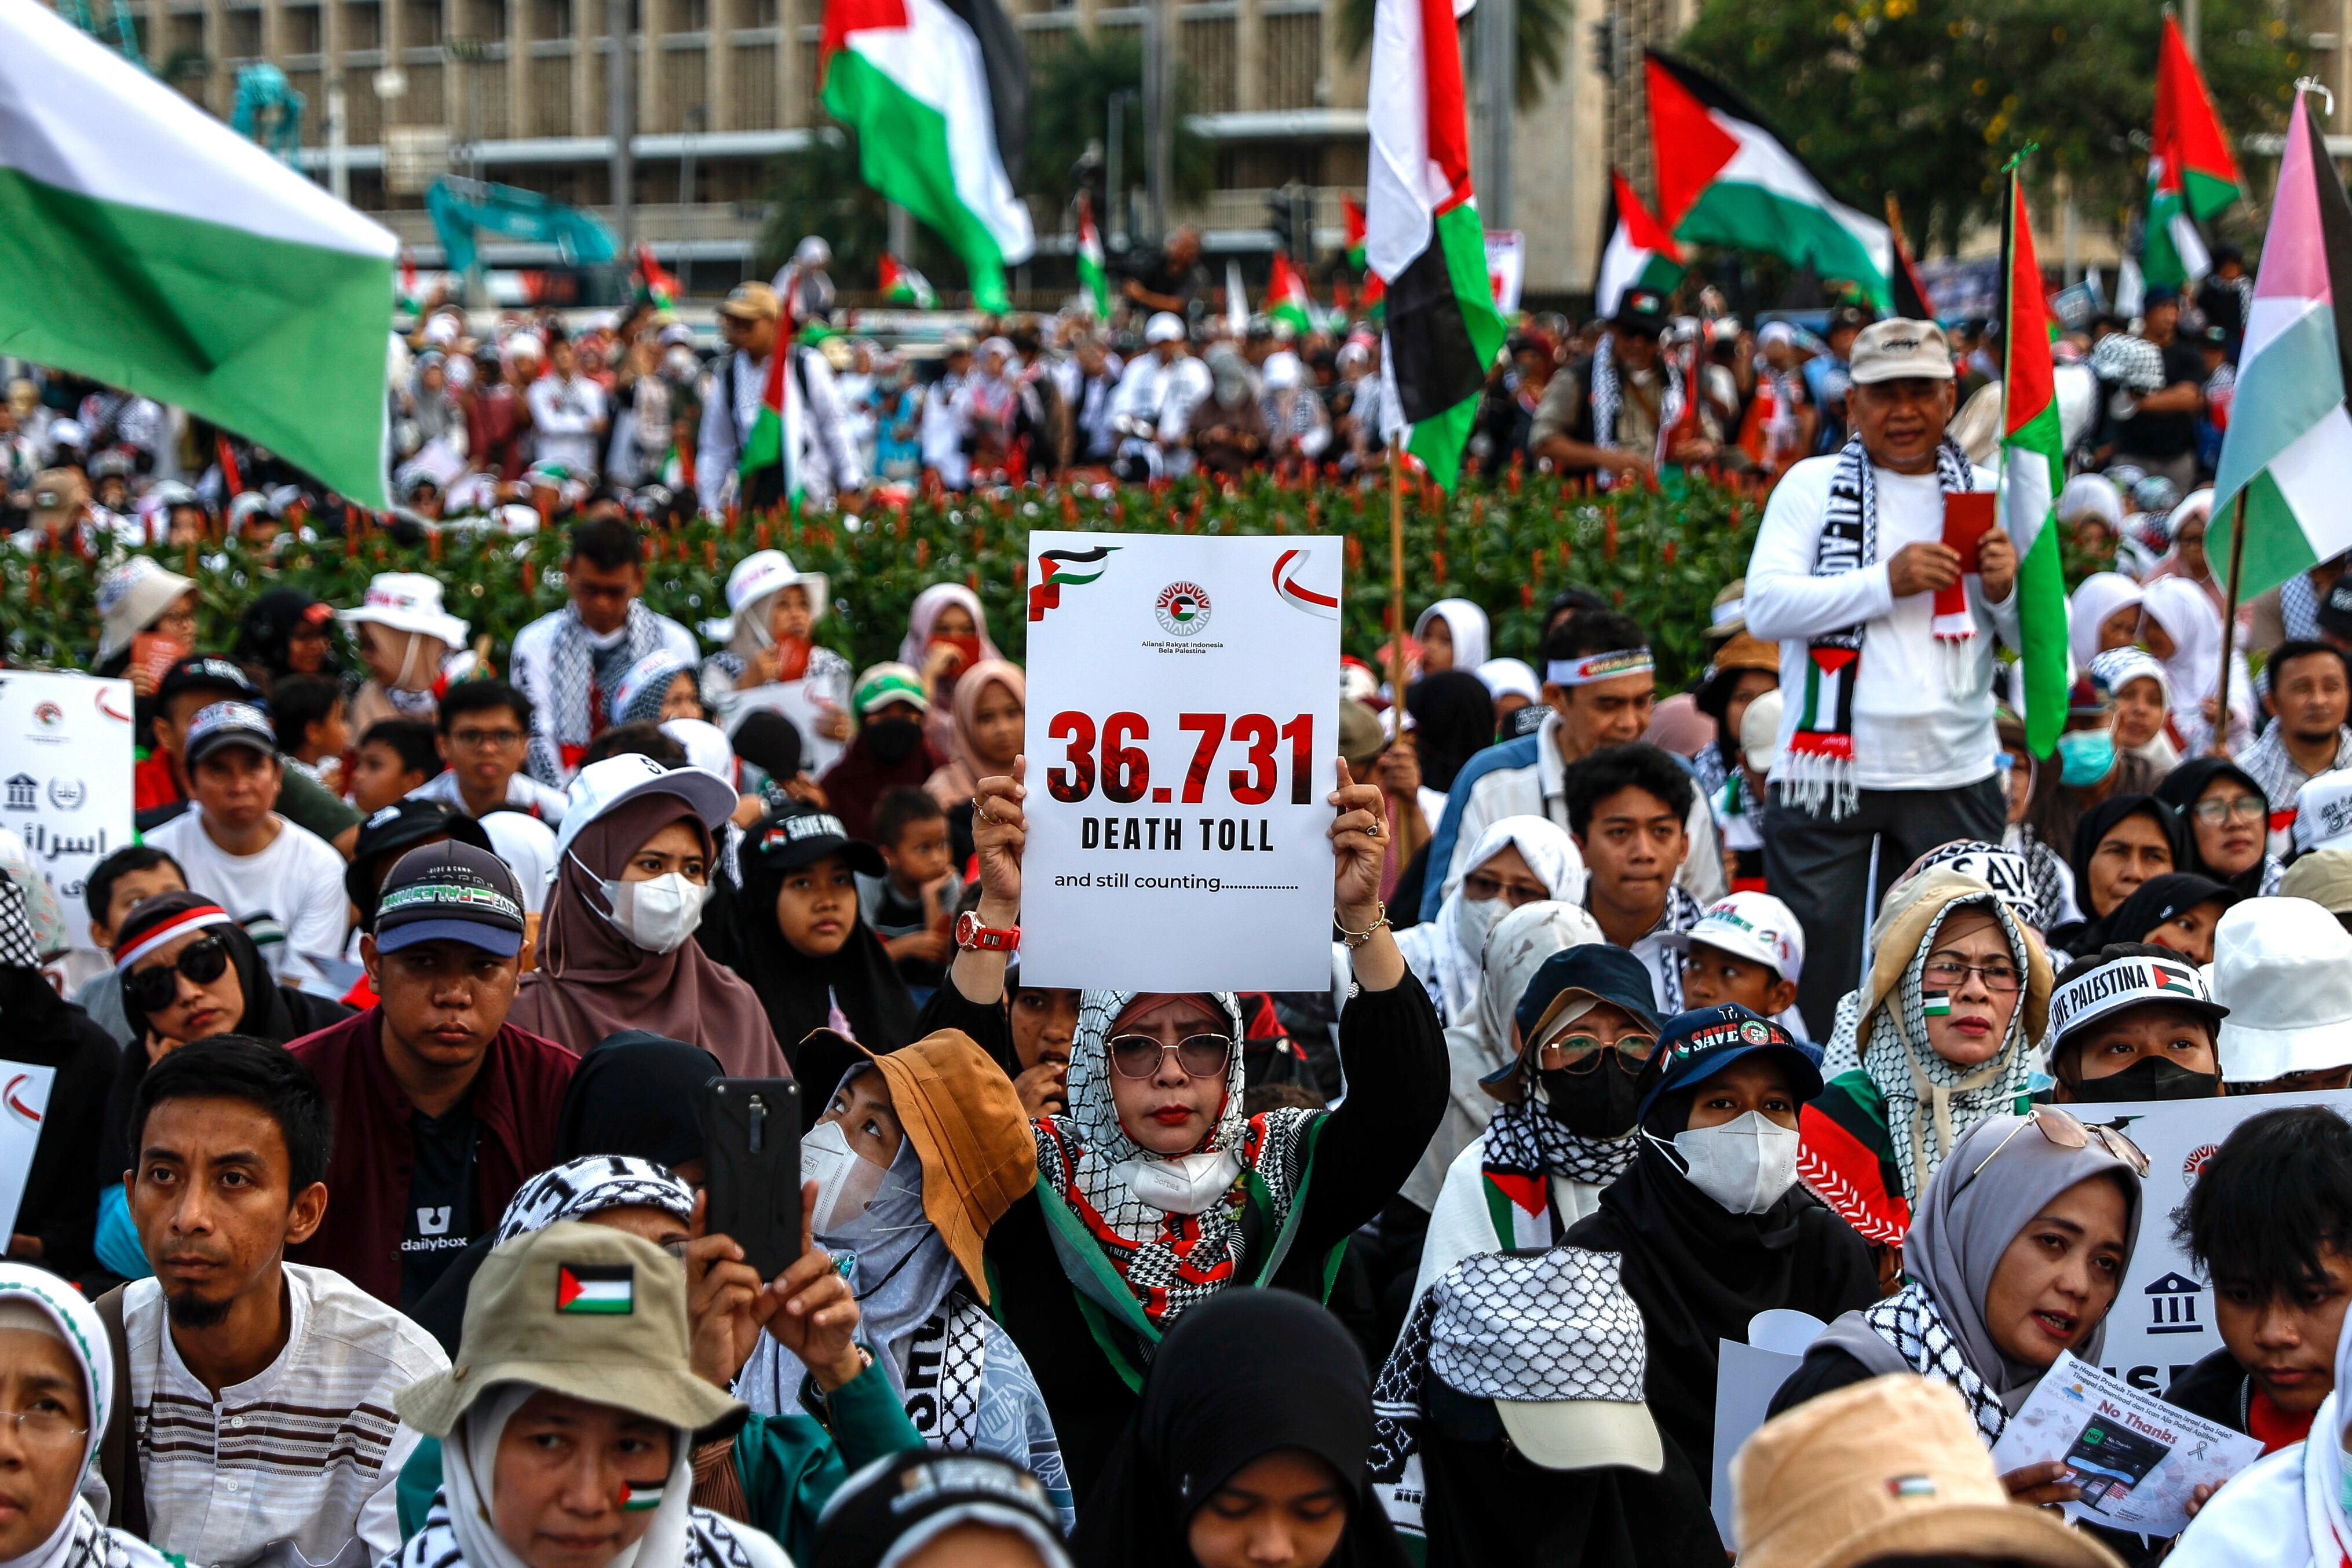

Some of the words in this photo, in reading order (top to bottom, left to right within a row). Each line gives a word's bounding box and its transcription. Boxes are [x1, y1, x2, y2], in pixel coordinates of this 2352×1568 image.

[1046, 711, 1313, 805] 36.731
[1082, 817, 1182, 850] DEATH
[1199, 818, 1274, 851] TOLL
[1054, 872, 1091, 887] and
[1096, 872, 1128, 888] still
[2051, 993, 2070, 1035] SAVE
[2069, 964, 2150, 1014] PALESTINA
[1690, 1022, 1739, 1052] SAVE
[1153, 1175, 1179, 1192] Softies
[400, 1236, 468, 1252] dailybox
[1109, 1245, 1131, 1259] FREE
[2068, 1361, 2079, 1369] Ga
[2099, 1376, 2125, 1393] Produk
[2157, 1403, 2183, 1420] Dengan
[2200, 1422, 2215, 1433] Apa
[2214, 1428, 2232, 1441] Saja?
[2072, 1372, 2098, 1388] Tinggal
[2097, 1384, 2132, 1405] Download
[2131, 1401, 2145, 1412] dan
[2145, 1408, 2160, 1419] Scan
[2160, 1414, 2173, 1424] Aja
[2172, 1419, 2192, 1432] Pakai
[2192, 1427, 2219, 1444] Aplikasi
[2087, 1431, 2099, 1440] NO
[2098, 1399, 2121, 1419] No
[2124, 1412, 2178, 1445] Thanks
